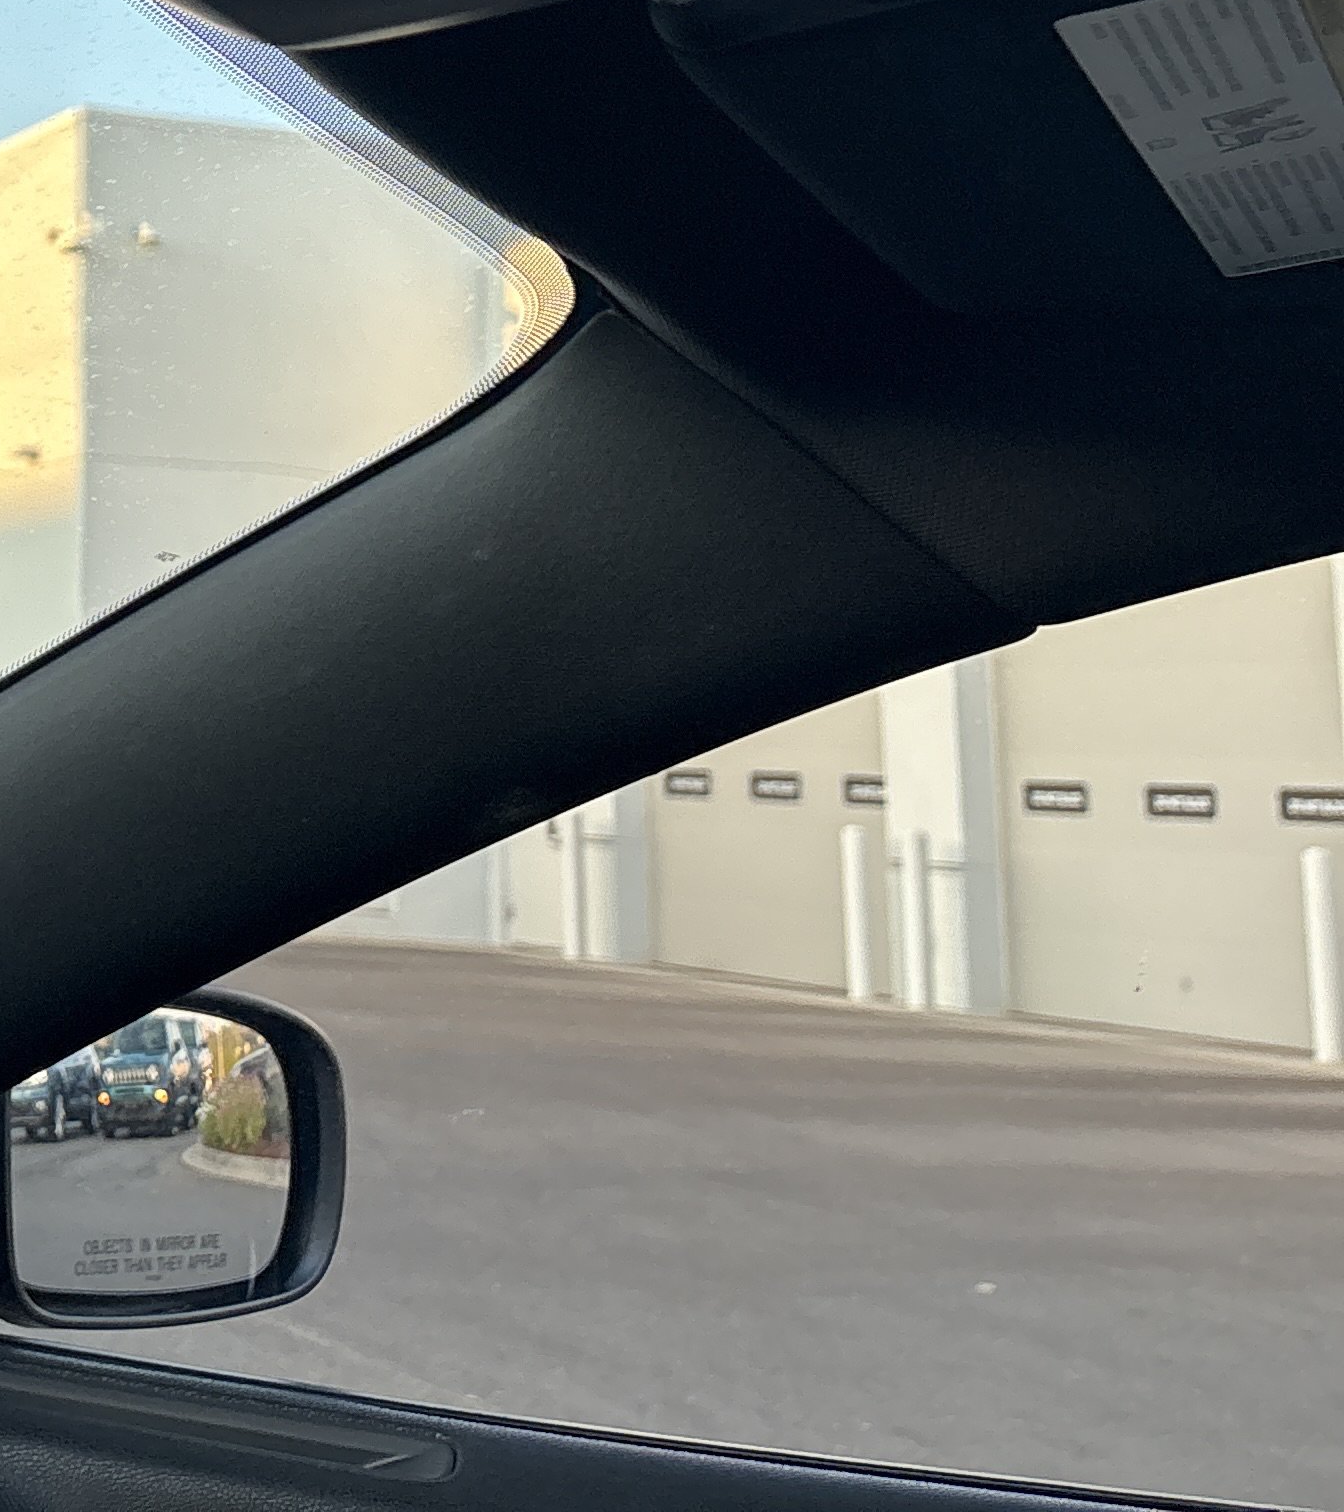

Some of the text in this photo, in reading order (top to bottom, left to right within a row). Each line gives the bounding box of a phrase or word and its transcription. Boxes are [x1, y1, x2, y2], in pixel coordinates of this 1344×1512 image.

[83, 1233, 220, 1255] OBJECTS IN MIRROR ARE
[74, 1253, 227, 1276] CLOSER THAN THEY APPEAR
